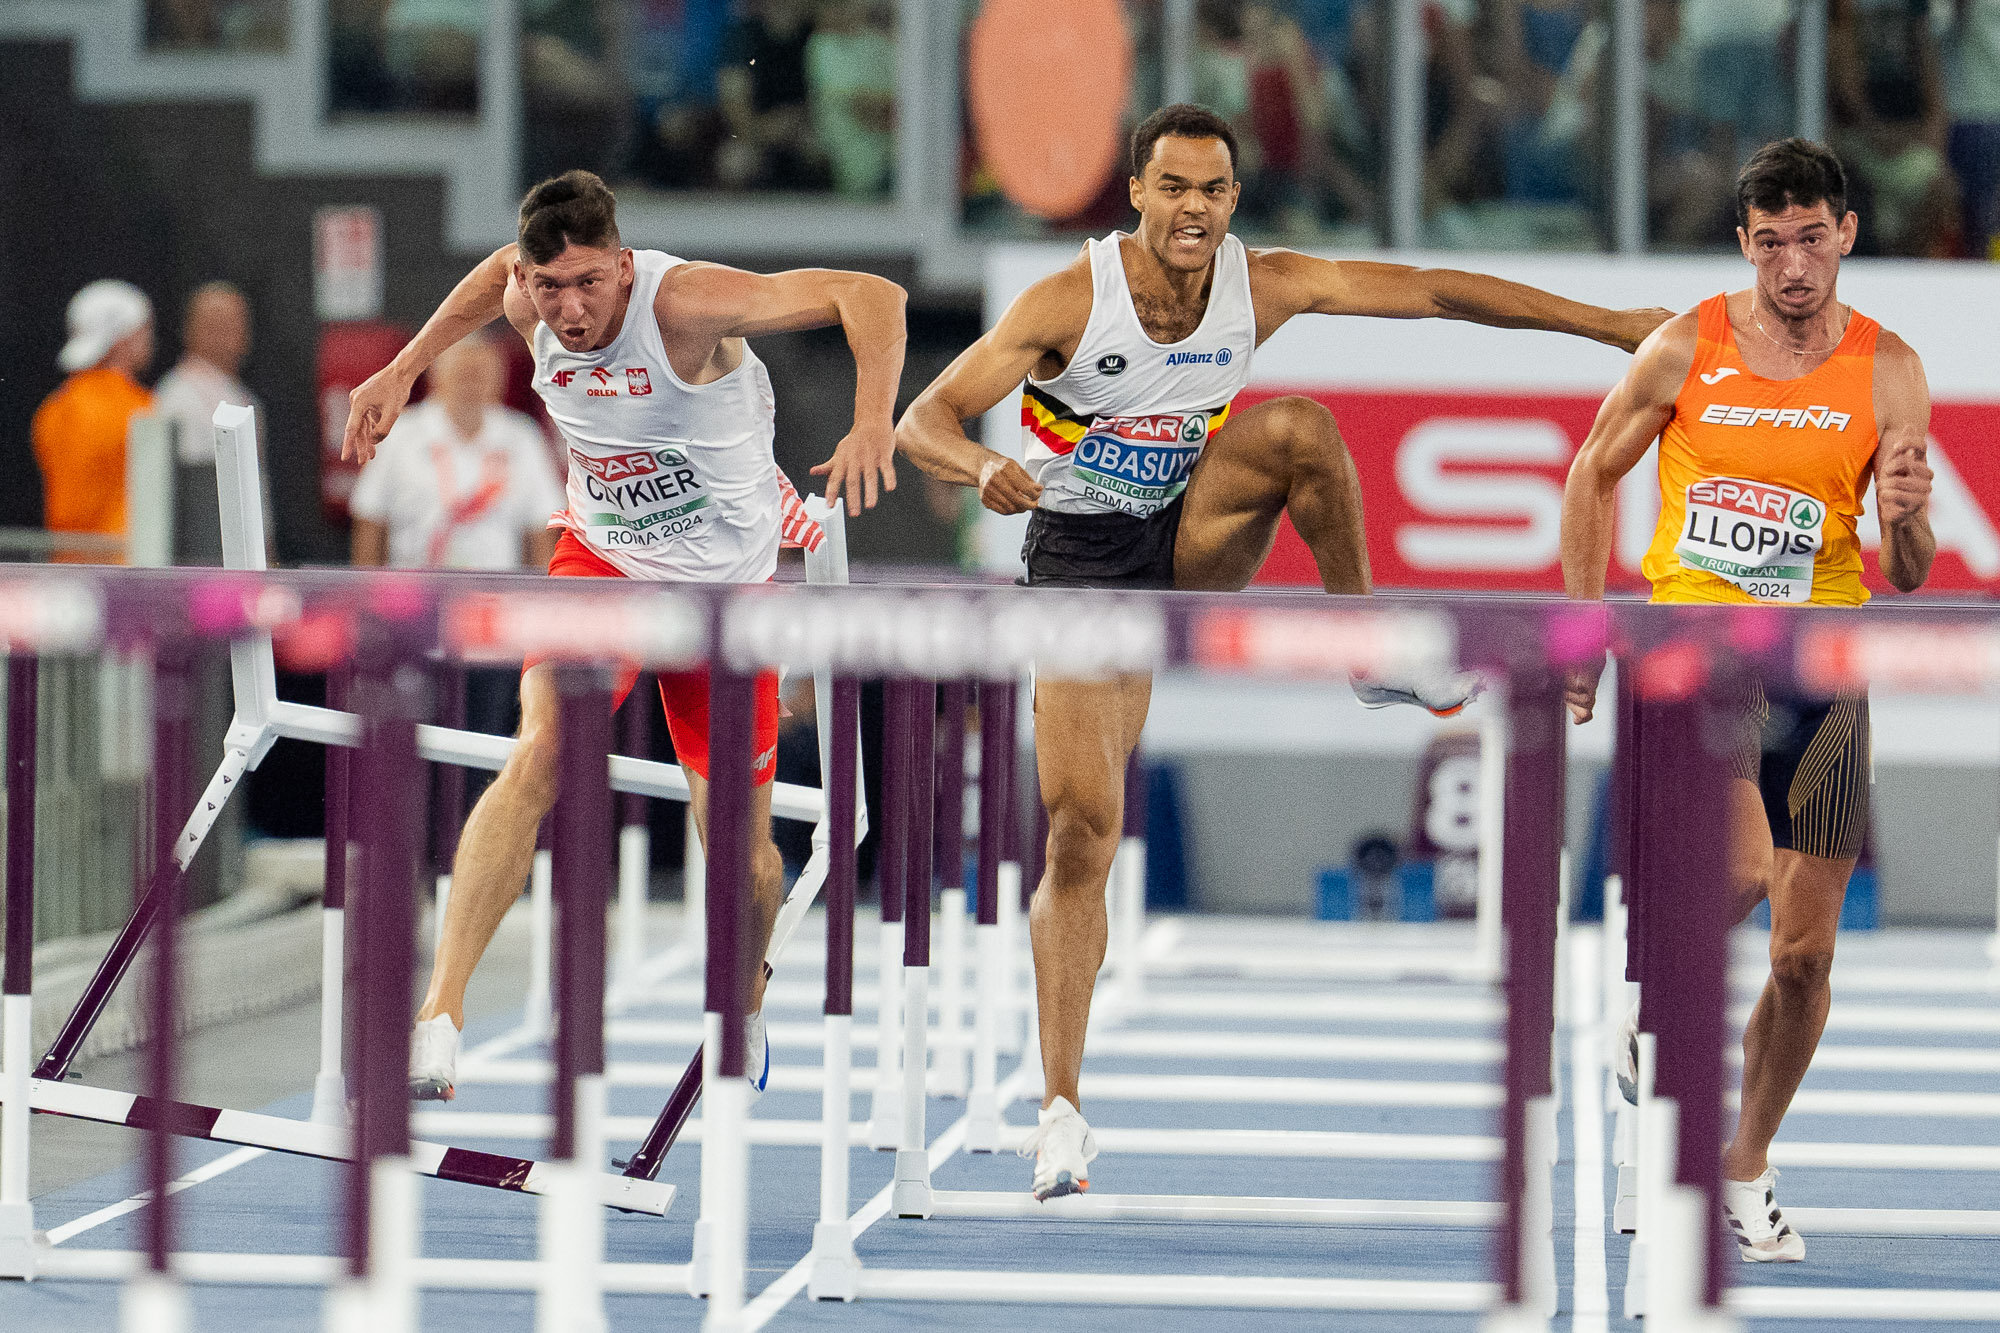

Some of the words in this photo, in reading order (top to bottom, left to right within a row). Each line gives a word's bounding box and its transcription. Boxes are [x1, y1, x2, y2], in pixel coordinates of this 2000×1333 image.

[1166, 352, 1213, 366] Allianz
[551, 369, 576, 387] 4F
[587, 388, 618, 397] ORLEN
[1699, 403, 1852, 432] ESPAÑA
[1095, 475, 1099, 485] I
[1100, 477, 1128, 493] RUN
[1084, 486, 1133, 513] ROMA
[1692, 482, 1786, 519] SPAR
[608, 530, 659, 546] ROMA
[661, 515, 703, 538] 2024
[1687, 511, 1814, 556] LLOPIS
[1701, 558, 1707, 566] I
[1707, 559, 1736, 574] RUN
[1748, 583, 1790, 597] 2024
